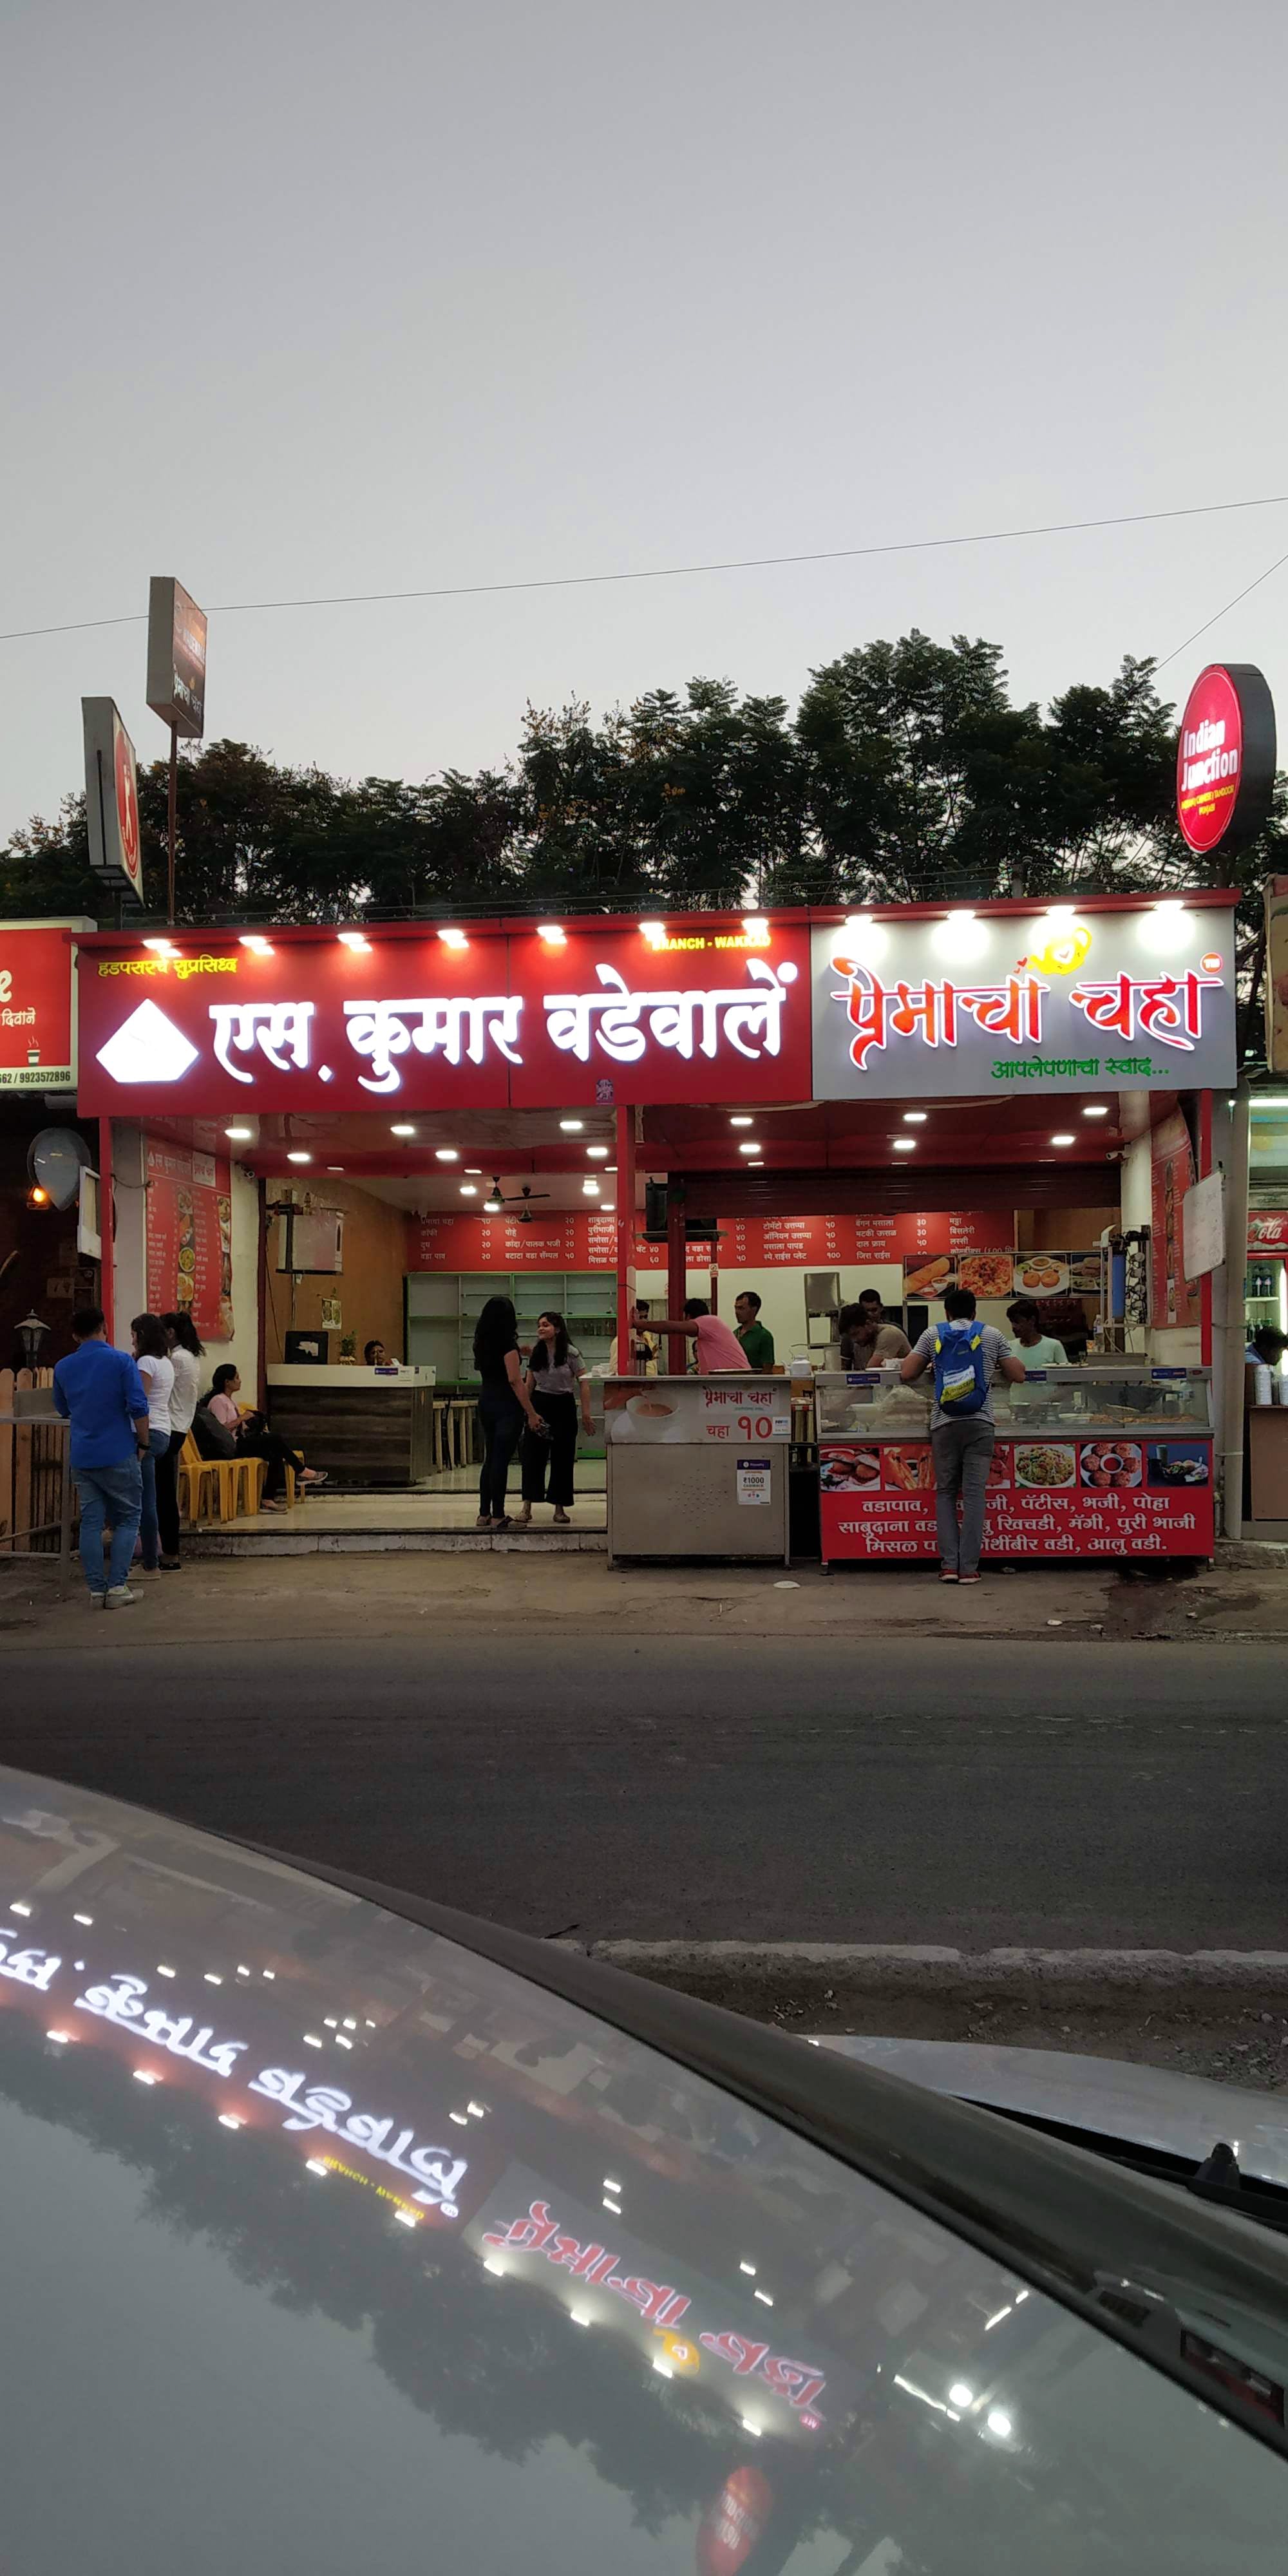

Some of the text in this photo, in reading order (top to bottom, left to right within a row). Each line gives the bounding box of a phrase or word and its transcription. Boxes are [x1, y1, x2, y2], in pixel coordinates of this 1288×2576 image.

[1183, 719, 1226, 759] Indian
[1181, 748, 1238, 791] Junction
[1, 1007, 36, 1027] दिवाने
[829, 956, 1224, 1071] प्रेमाचा चहा
[343, 997, 524, 1093] कुमार
[19, 1071, 71, 1083] 9923572896
[991, 1055, 1100, 1079] आपलेपणाचा
[546, 1238, 561, 1247] भजी
[917, 1228, 927, 1236] ३०
[702, 1386, 775, 1408] प्रेमाचा चहा
[706, 1416, 772, 1441] चहा १०
[862, 1500, 929, 1514] वडापाव,
[1021, 1493, 1076, 1513] पॅटीस,
[1082, 1492, 1126, 1512] भजी,
[1133, 1492, 1170, 1511] पोहा
[838, 1520, 909, 1538] साबुदाना
[996, 1514, 1062, 1534] खिचडी,
[1068, 1513, 1111, 1533] मॅगी,
[1117, 1513, 1147, 1535] पुरी
[1153, 1513, 1196, 1530] भाजी
[866, 1537, 918, 1553] मिसळ
[1043, 1533, 1081, 1553] वडी,
[1131, 1533, 1167, 1551] वडी.
